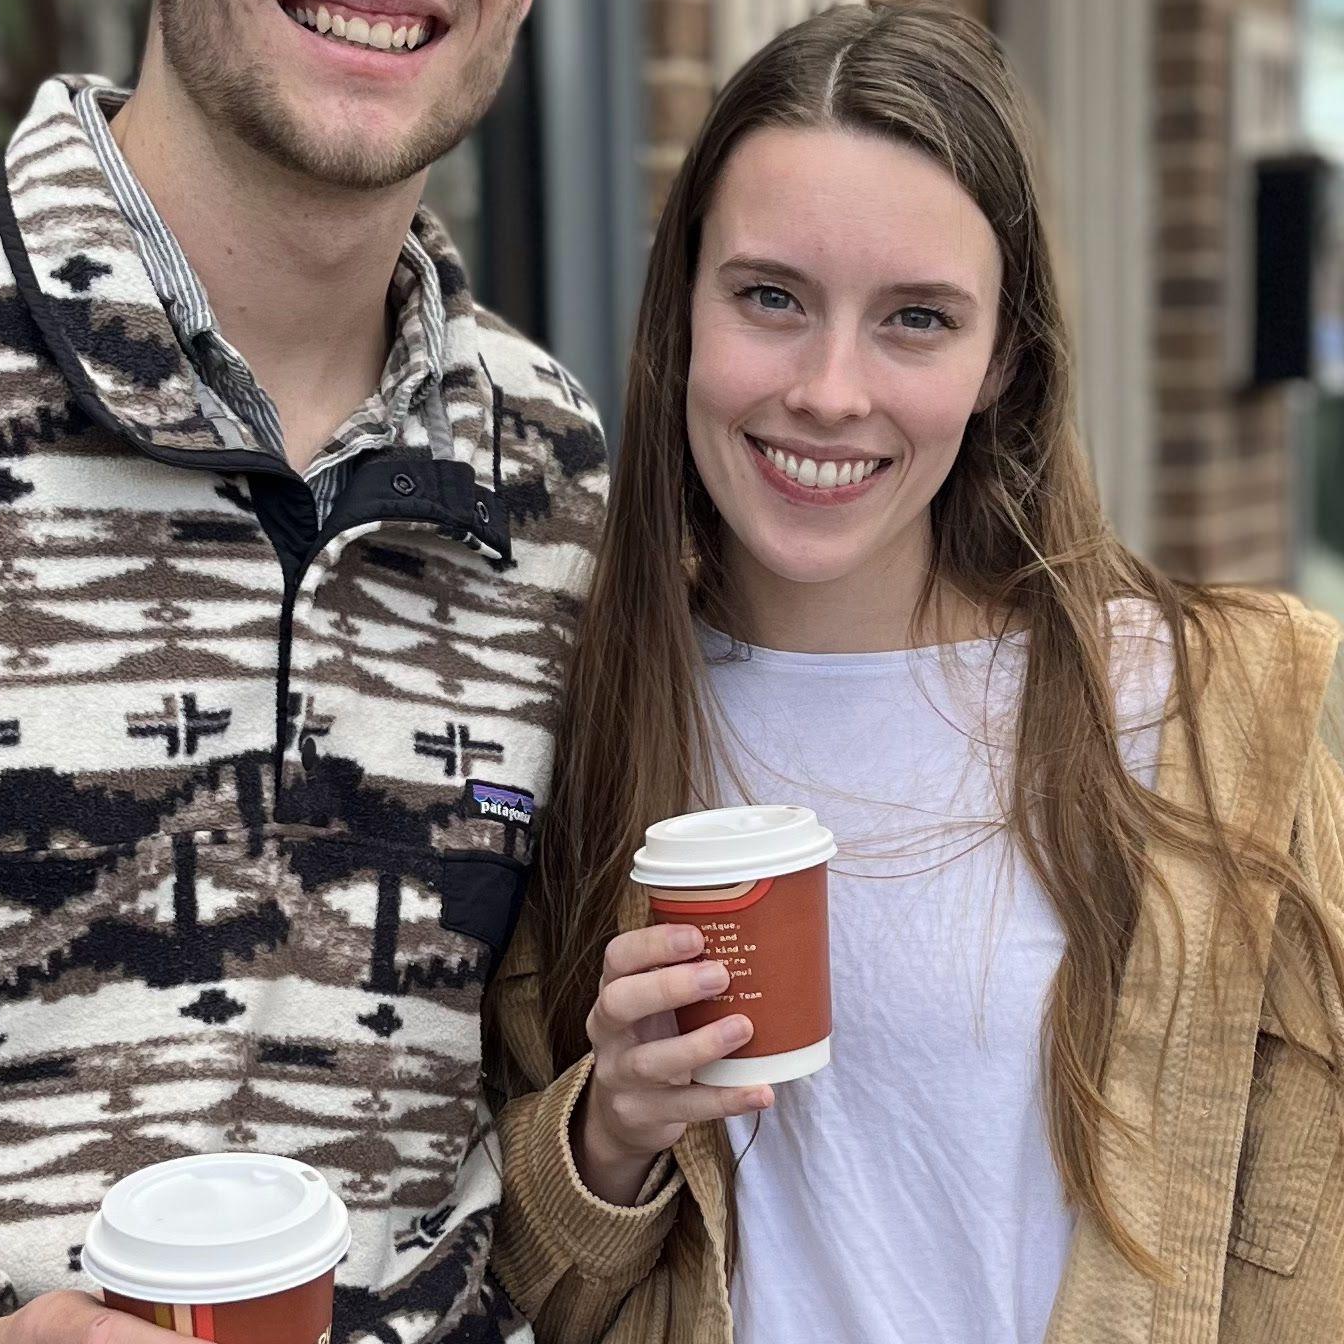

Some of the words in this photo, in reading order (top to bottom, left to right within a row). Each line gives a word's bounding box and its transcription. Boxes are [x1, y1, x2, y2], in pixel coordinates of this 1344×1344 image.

[720, 934, 737, 942] and
[716, 946, 739, 954] kind
[744, 944, 757, 952] to
[739, 992, 763, 1000] Team
